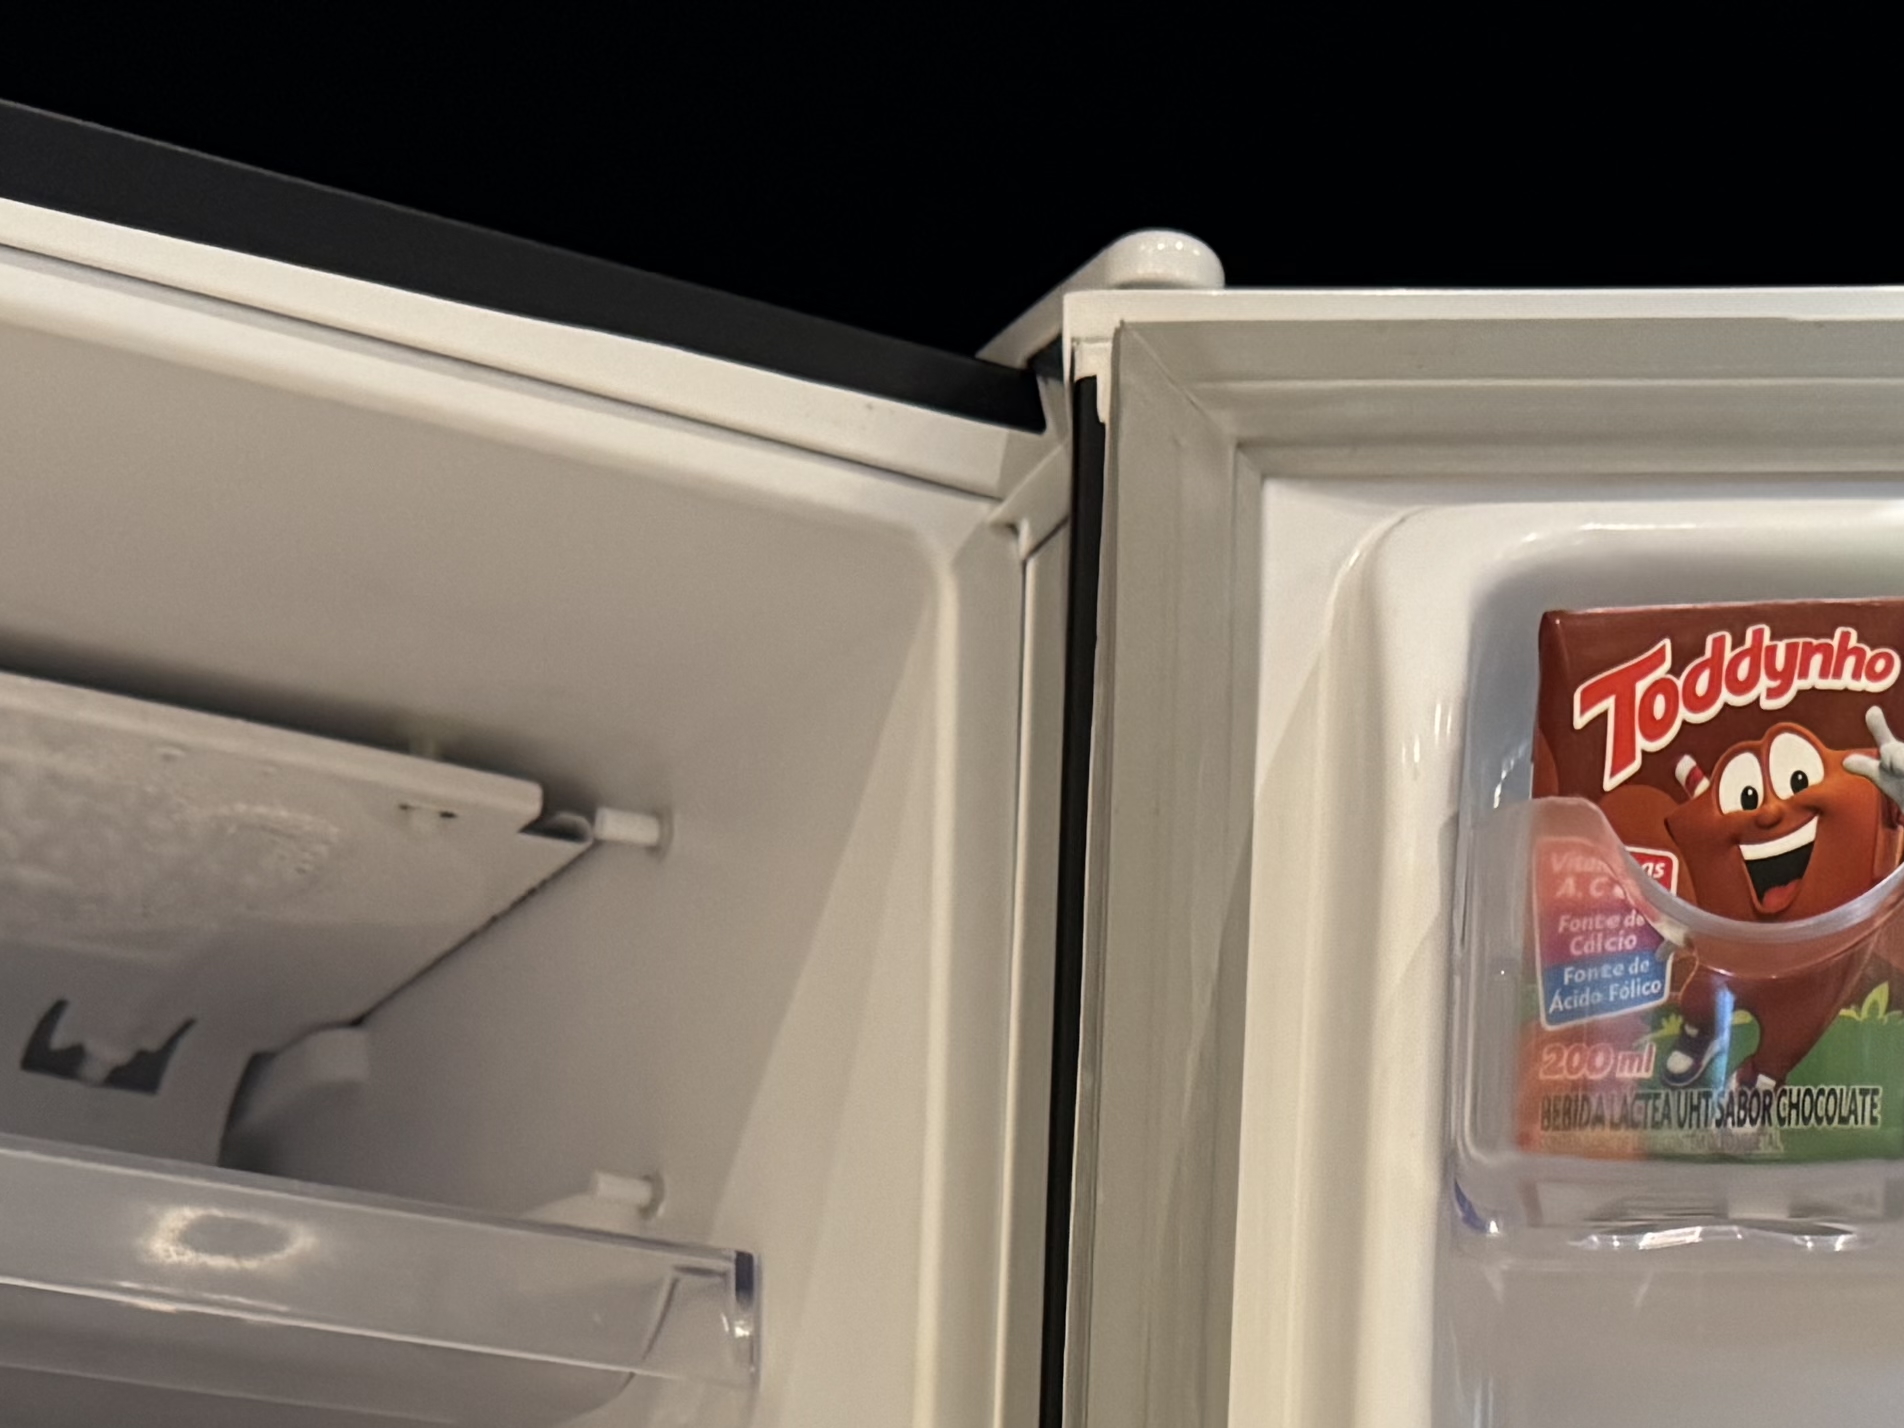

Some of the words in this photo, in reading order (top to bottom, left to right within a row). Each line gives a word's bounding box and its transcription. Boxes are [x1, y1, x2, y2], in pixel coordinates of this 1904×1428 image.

[1573, 624, 1901, 792] Toddynho
[1563, 962, 1625, 986] Fonte
[1628, 957, 1650, 975] de
[1548, 987, 1603, 1014] Ácido
[1609, 976, 1662, 1002] Fólico
[1675, 1088, 1713, 1129] UHT
[1714, 1086, 1773, 1129] SABOR
[1775, 1084, 1881, 1128] CHOCOLATE
